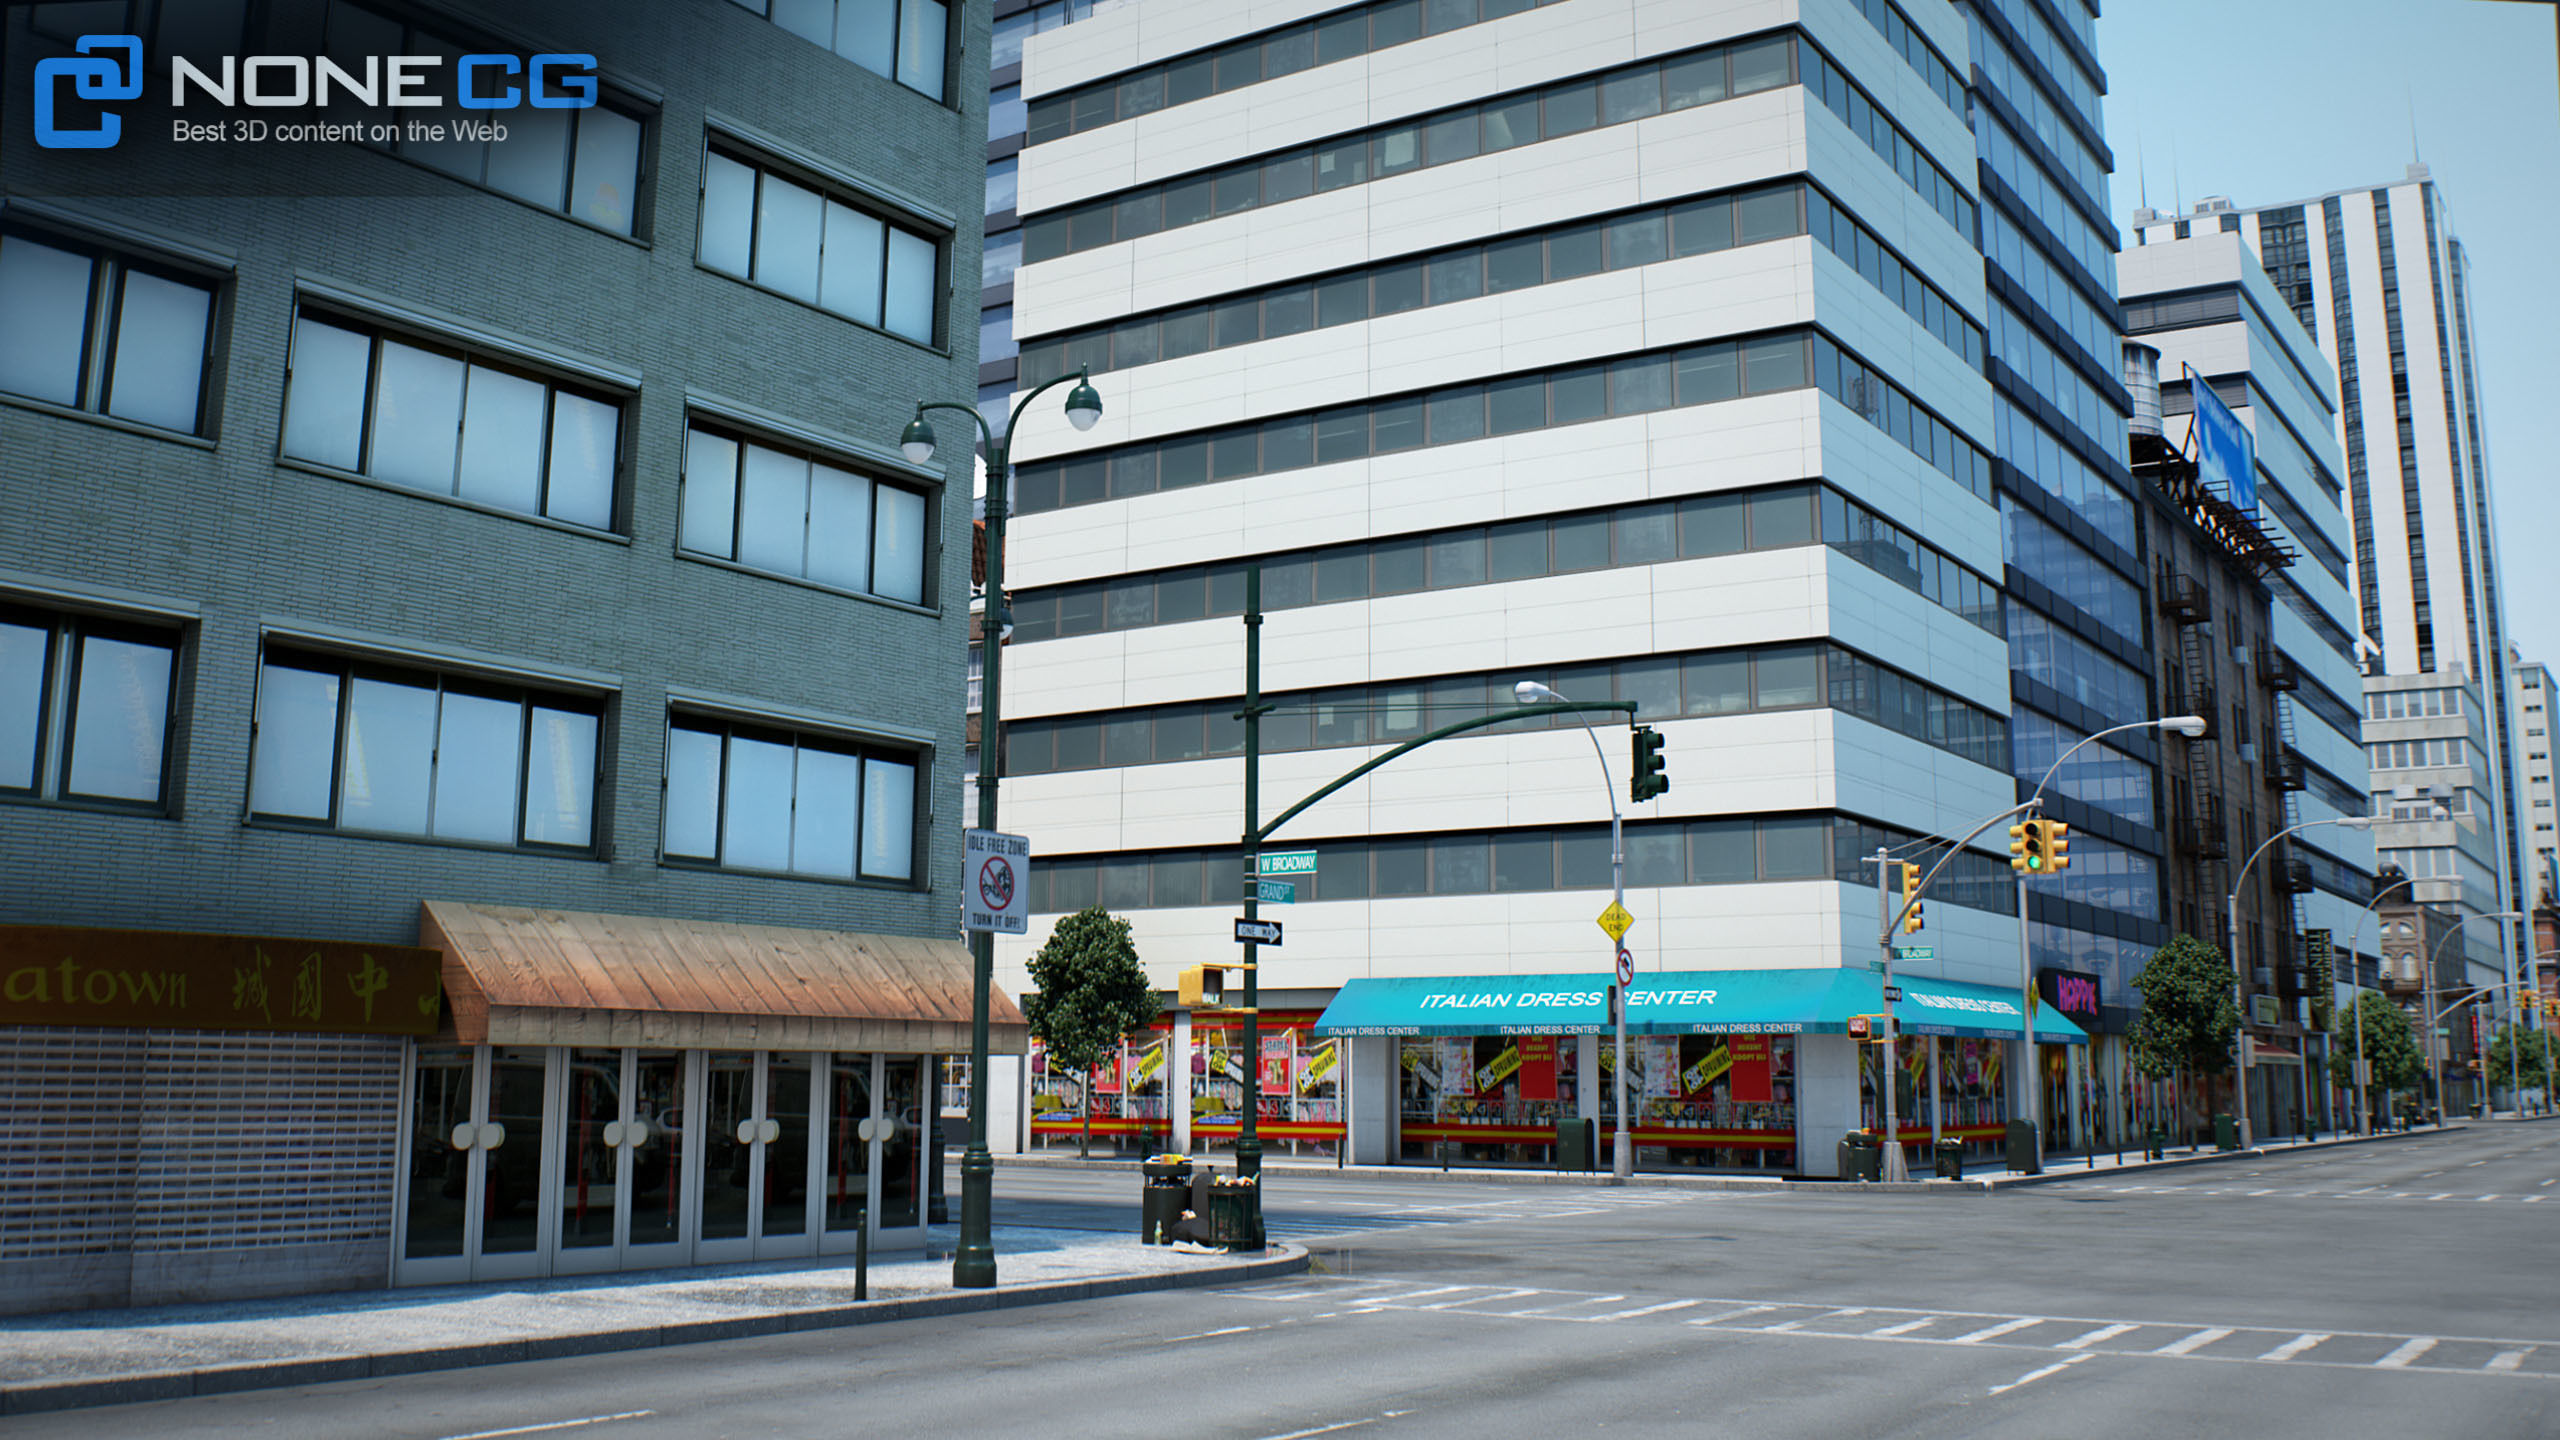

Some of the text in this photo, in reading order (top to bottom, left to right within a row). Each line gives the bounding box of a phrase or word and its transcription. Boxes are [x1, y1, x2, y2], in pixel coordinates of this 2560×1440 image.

[968, 834, 1027, 856] IDLE FREE ZONE
[1261, 856, 1315, 872] W BROADWAY
[1259, 883, 1284, 900] GRAND
[972, 912, 992, 926] TURN
[995, 914, 1003, 926] IT
[1606, 913, 1626, 921] DEAD
[1241, 926, 1276, 938] ONE WAY
[1608, 924, 1624, 932] END
[1420, 989, 1717, 1008] ITALIAN DRESS ENTER
[1328, 1026, 1420, 1036] ITALIAN DRESS CENTER
[1501, 1025, 1600, 1034] ITALIAN DRESS CENTER
[1693, 1023, 1802, 1032] ITALIAN DRESS CENTER
